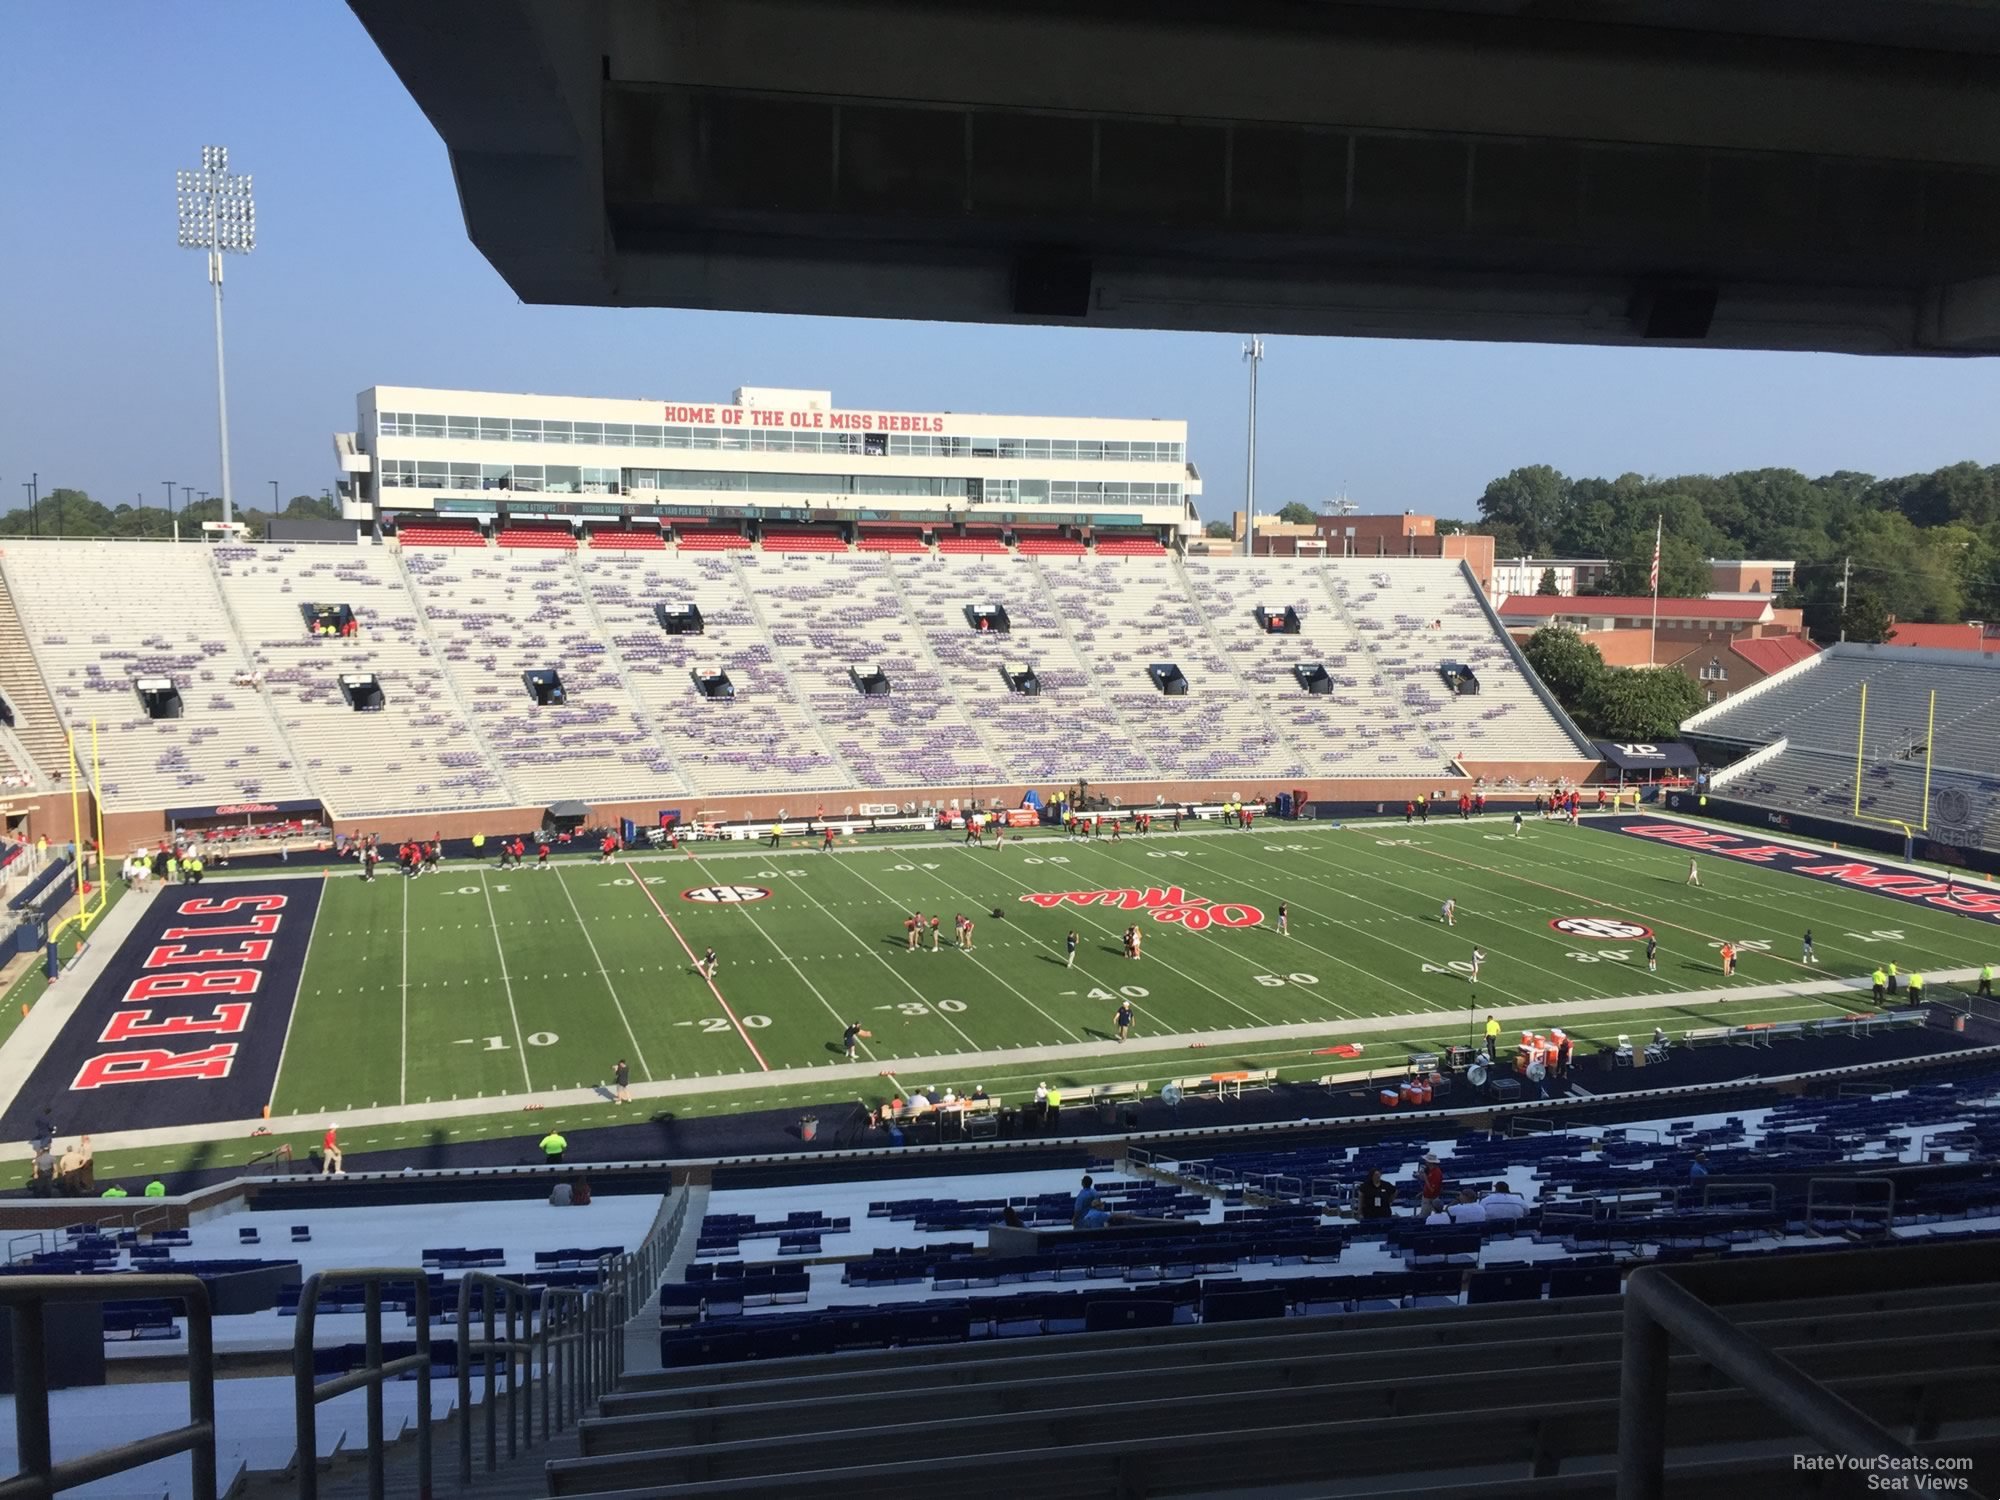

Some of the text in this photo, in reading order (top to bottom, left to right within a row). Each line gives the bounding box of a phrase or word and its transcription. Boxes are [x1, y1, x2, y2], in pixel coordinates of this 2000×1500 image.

[664, 406, 943, 432] HOME OF THE OLE MISS REBELS
[1767, 812, 1789, 824] FedEx
[1621, 824, 1822, 862] OLE
[69, 894, 288, 1091] REBELS
